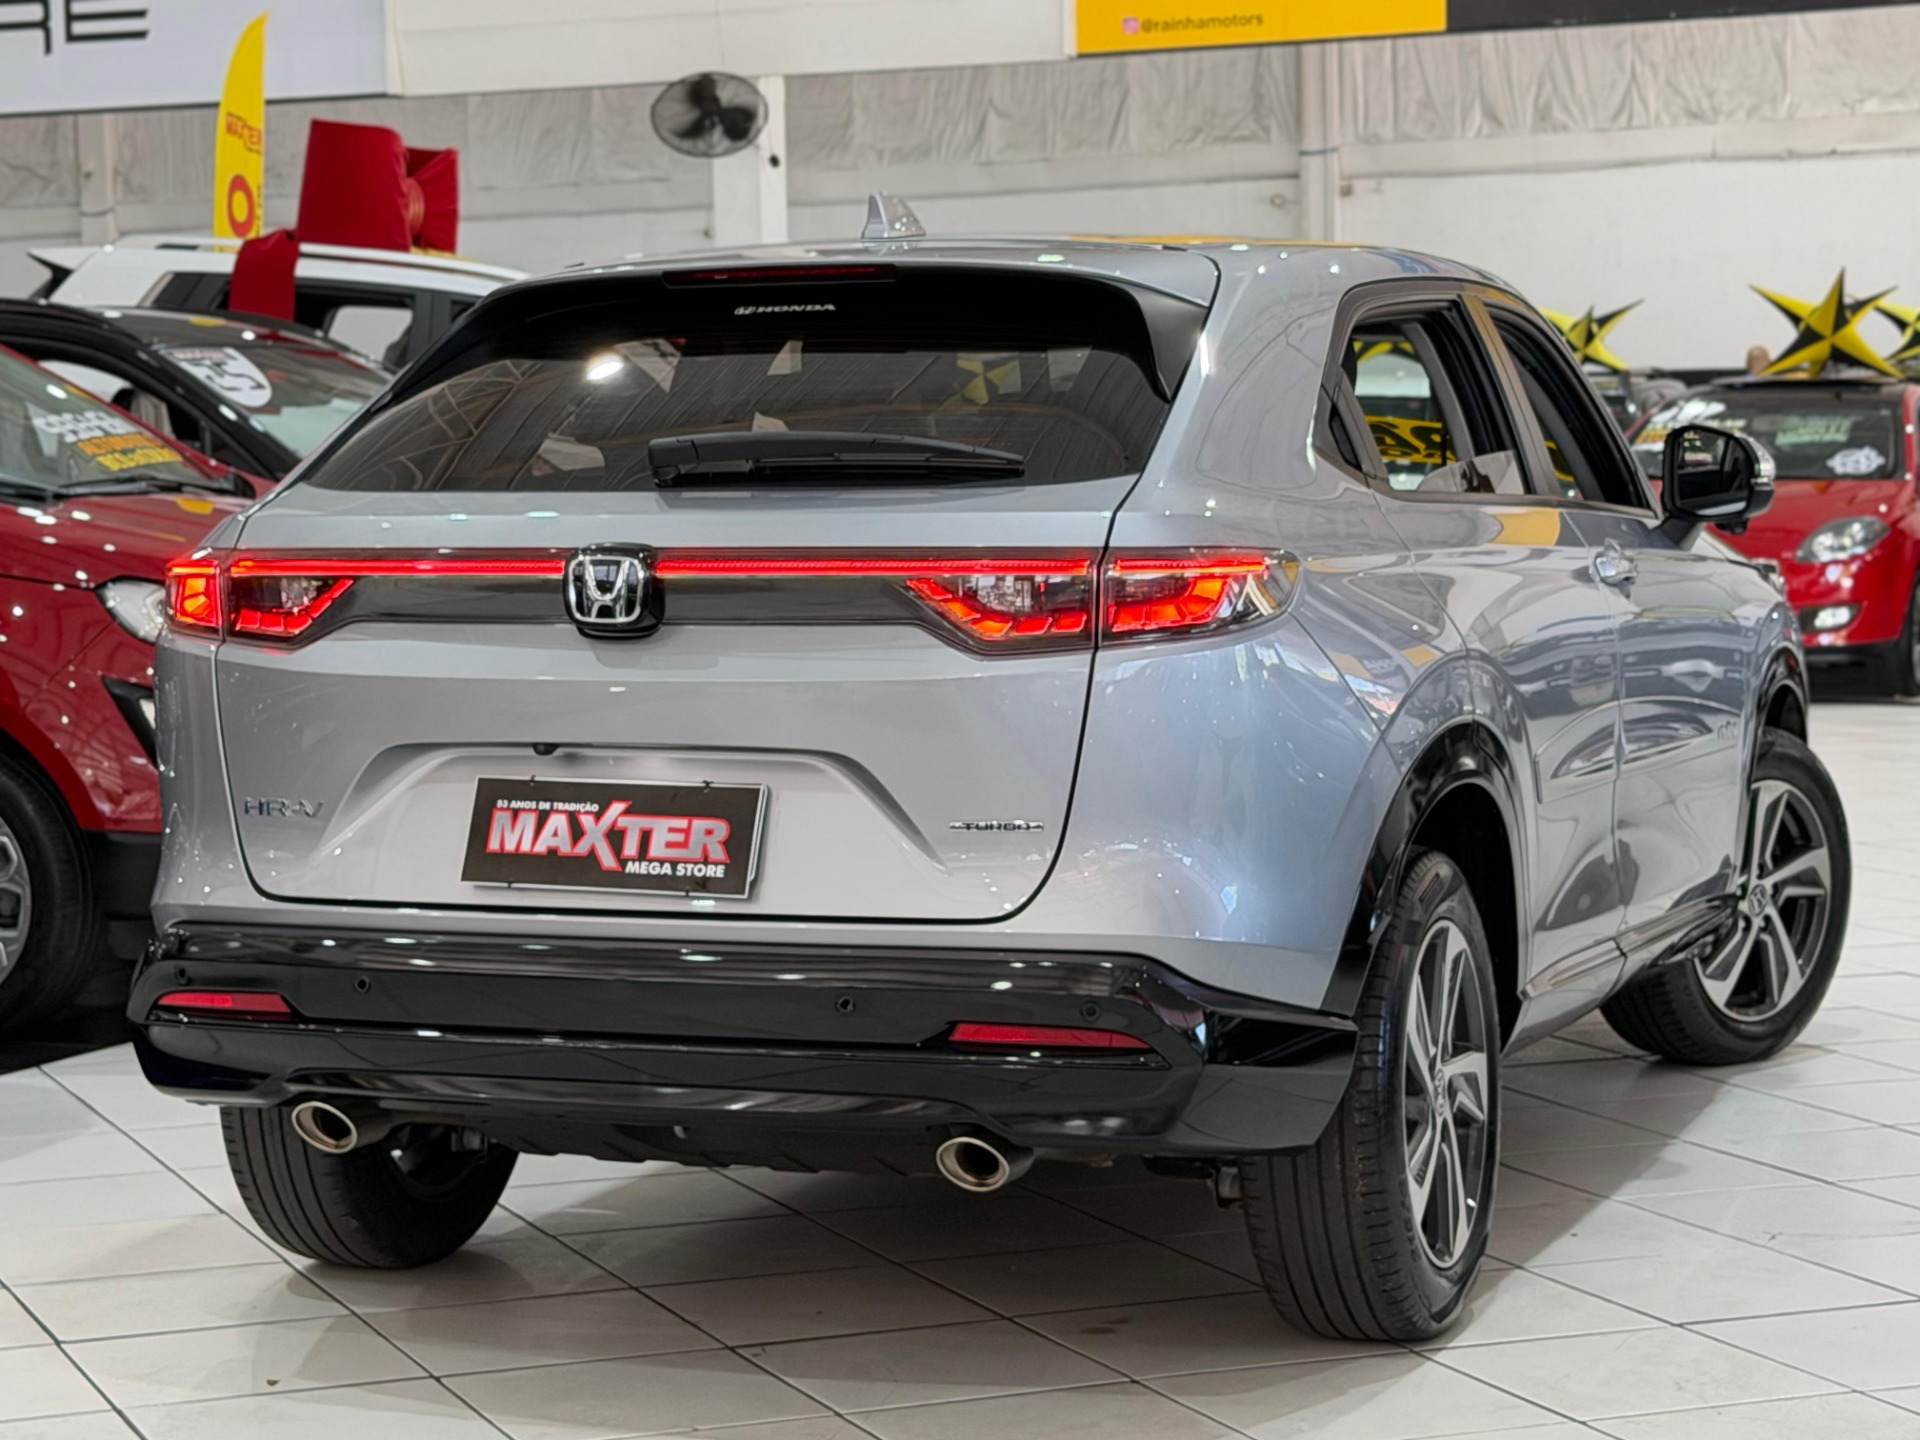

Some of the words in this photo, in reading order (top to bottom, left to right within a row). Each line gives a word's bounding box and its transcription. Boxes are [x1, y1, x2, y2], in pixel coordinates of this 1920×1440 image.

[1141, 14, 1263, 33] @rainhamotors
[757, 304, 836, 313] HONDA
[243, 797, 324, 818] HR-V
[510, 800, 537, 809] ANOS
[538, 801, 551, 810] DE
[552, 801, 600, 812] TRADIÇÃO
[961, 820, 1031, 831] TURBO
[486, 800, 731, 872] MAXTER
[625, 861, 672, 876] MEGA
[676, 863, 726, 878] STORE
